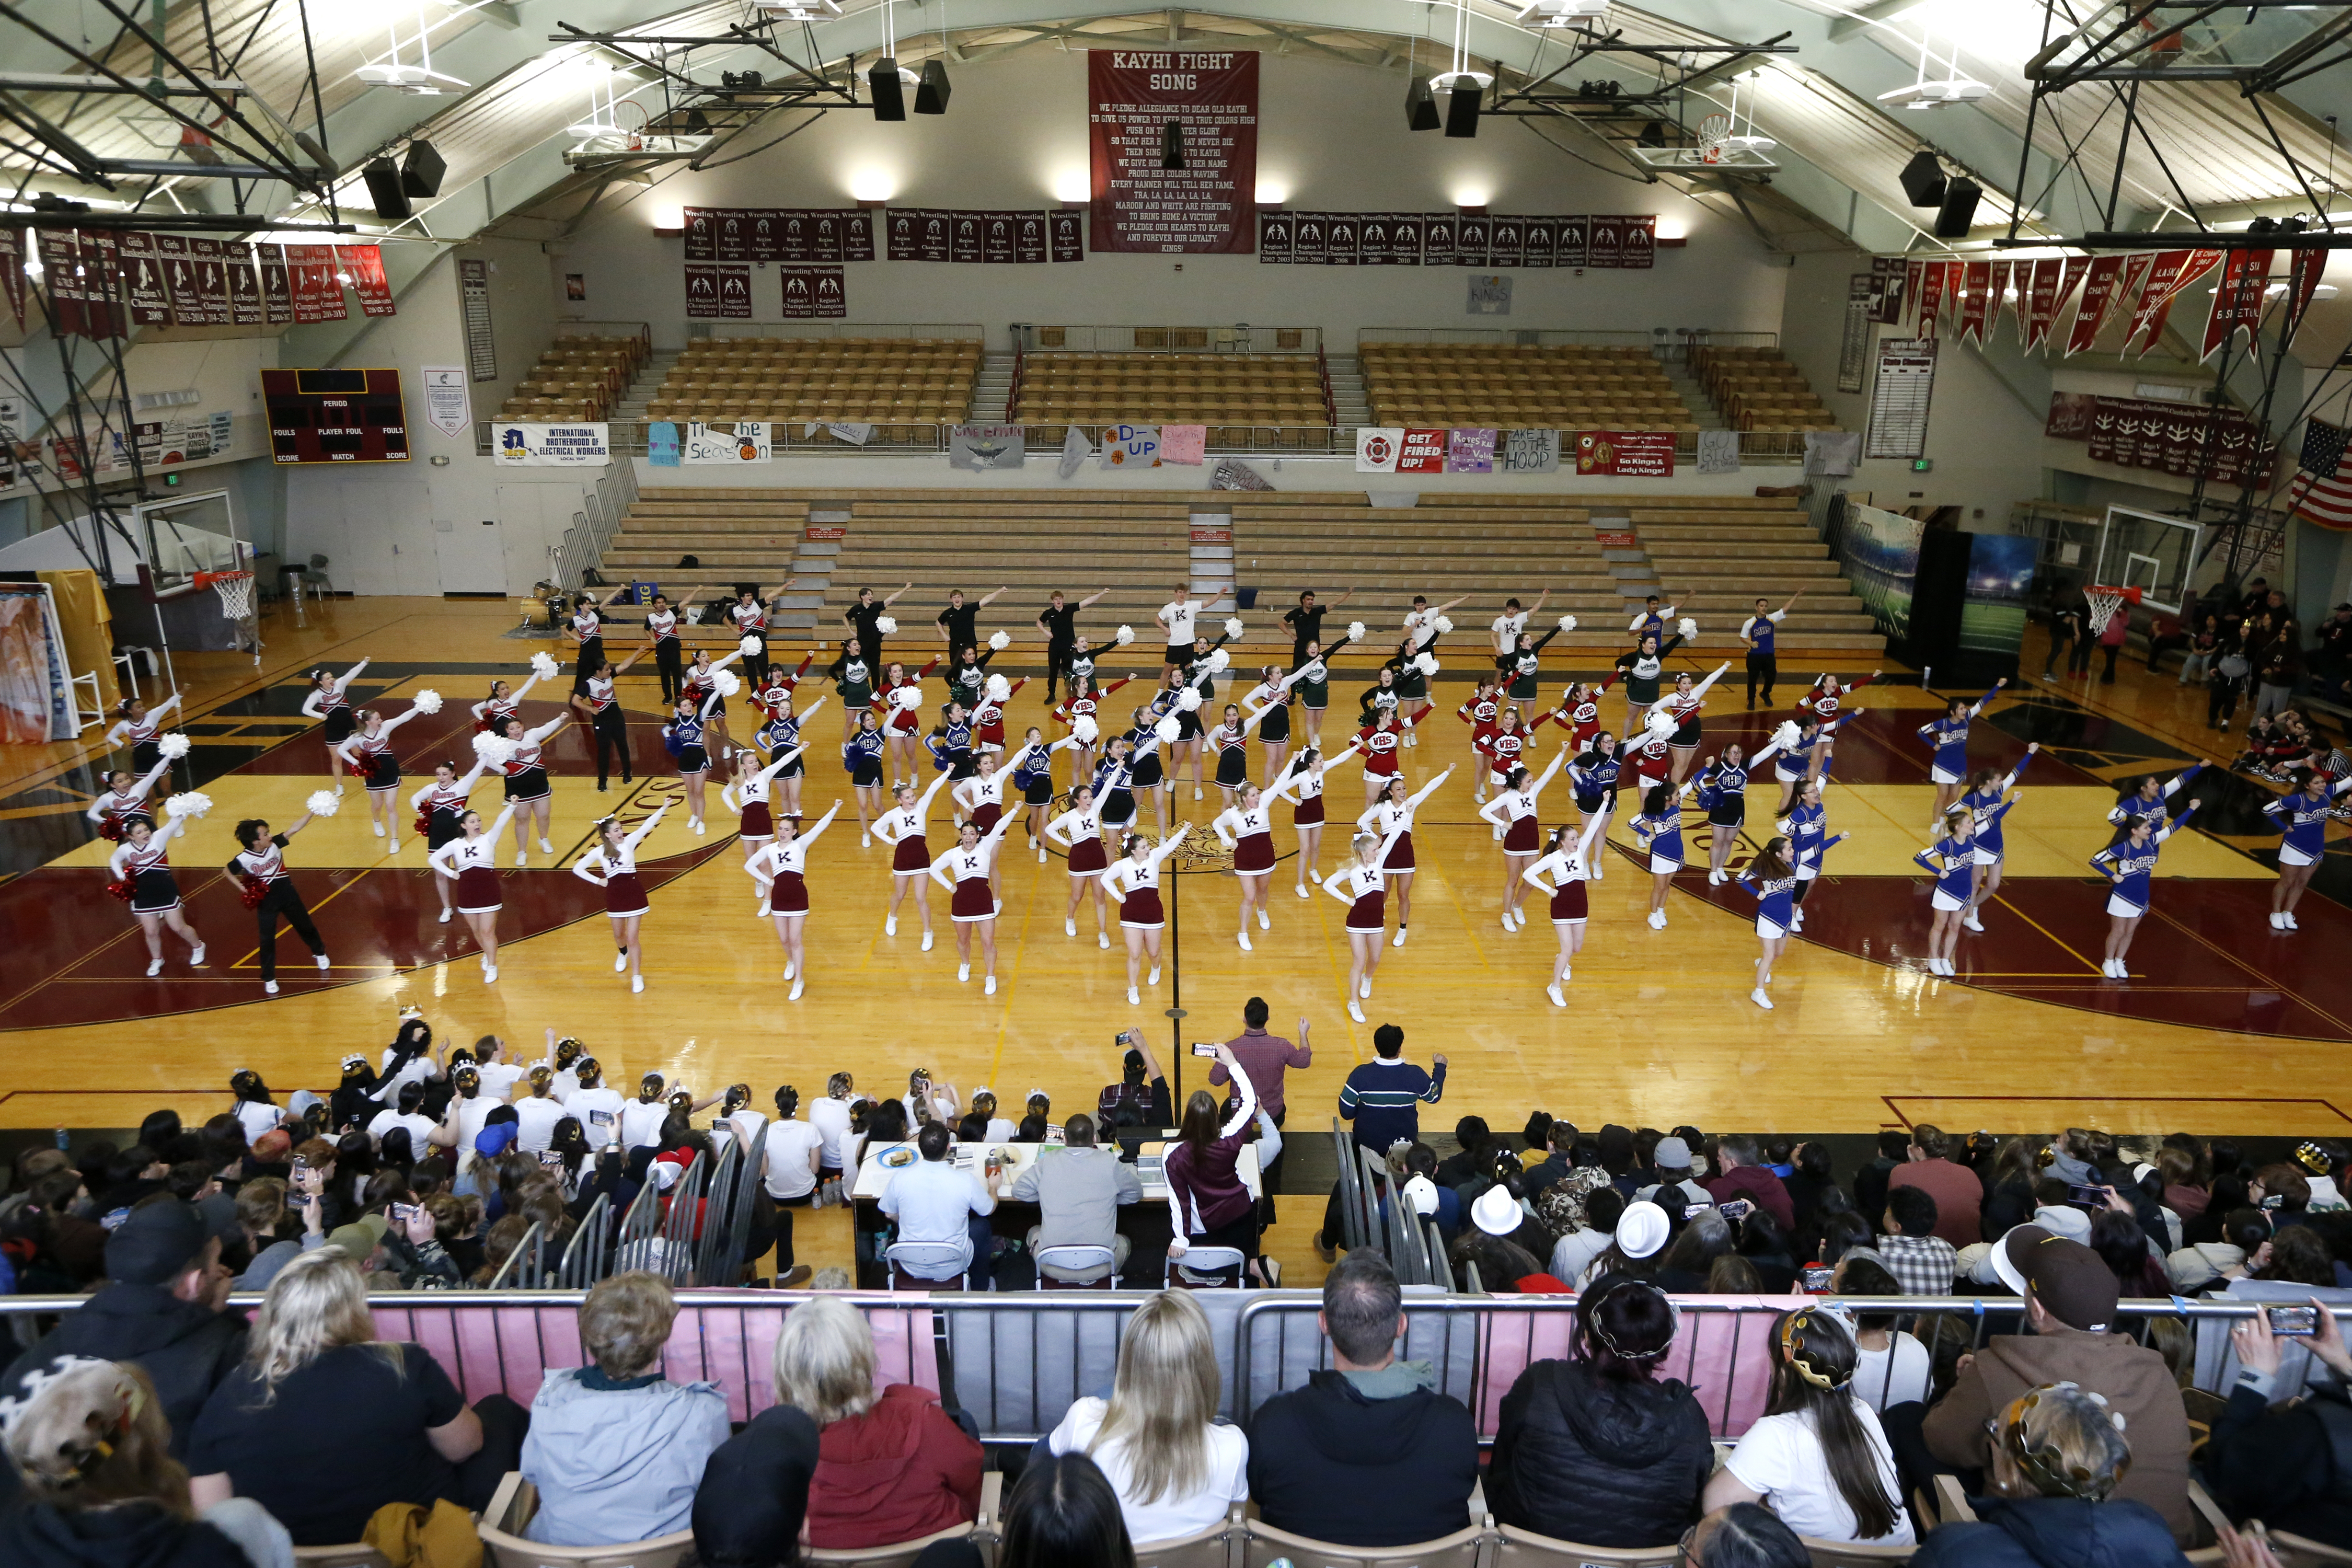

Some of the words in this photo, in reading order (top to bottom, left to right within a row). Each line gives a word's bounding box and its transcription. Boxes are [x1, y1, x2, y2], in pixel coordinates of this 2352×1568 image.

[1113, 53, 1171, 68] KAYHI
[1179, 54, 1233, 69] FIGHT
[1150, 74, 1196, 90] SONG
[1472, 289, 1507, 302] KINGS
[549, 429, 595, 437] INTERNATIONAL
[1120, 425, 1147, 441] D-
[1408, 434, 1433, 444] GET
[1454, 431, 1480, 445] Roses
[1129, 442, 1156, 455] UP
[1453, 446, 1471, 455] RED
[1511, 440, 1526, 451] TO
[1528, 438, 1551, 451] THE
[539, 447, 574, 455] ELECTRICAL
[1404, 446, 1440, 456] FIRED
[1702, 448, 1734, 463] BIG
[1401, 458, 1423, 468] UP!
[1506, 452, 1549, 469] HOOP
[1174, 609, 1187, 622] K
[1504, 622, 1517, 635] K
[1754, 627, 1772, 637] MHS
[773, 729, 794, 740] PHS
[860, 738, 877, 748] PHS
[1029, 758, 1045, 768] PHS
[1723, 775, 1744, 785] PHS
[746, 783, 758, 795] K
[1520, 798, 1532, 808] K
[2306, 808, 2330, 821] MHS
[904, 815, 917, 827] K
[1244, 815, 1258, 827] K
[464, 846, 478, 858] K
[778, 851, 792, 863] K
[964, 857, 977, 869] K
[1565, 860, 1578, 872] K
[2129, 856, 2153, 870] MHS
[1134, 868, 1149, 881] K
[1363, 870, 1378, 883] K
[1771, 877, 1797, 889] MHS
